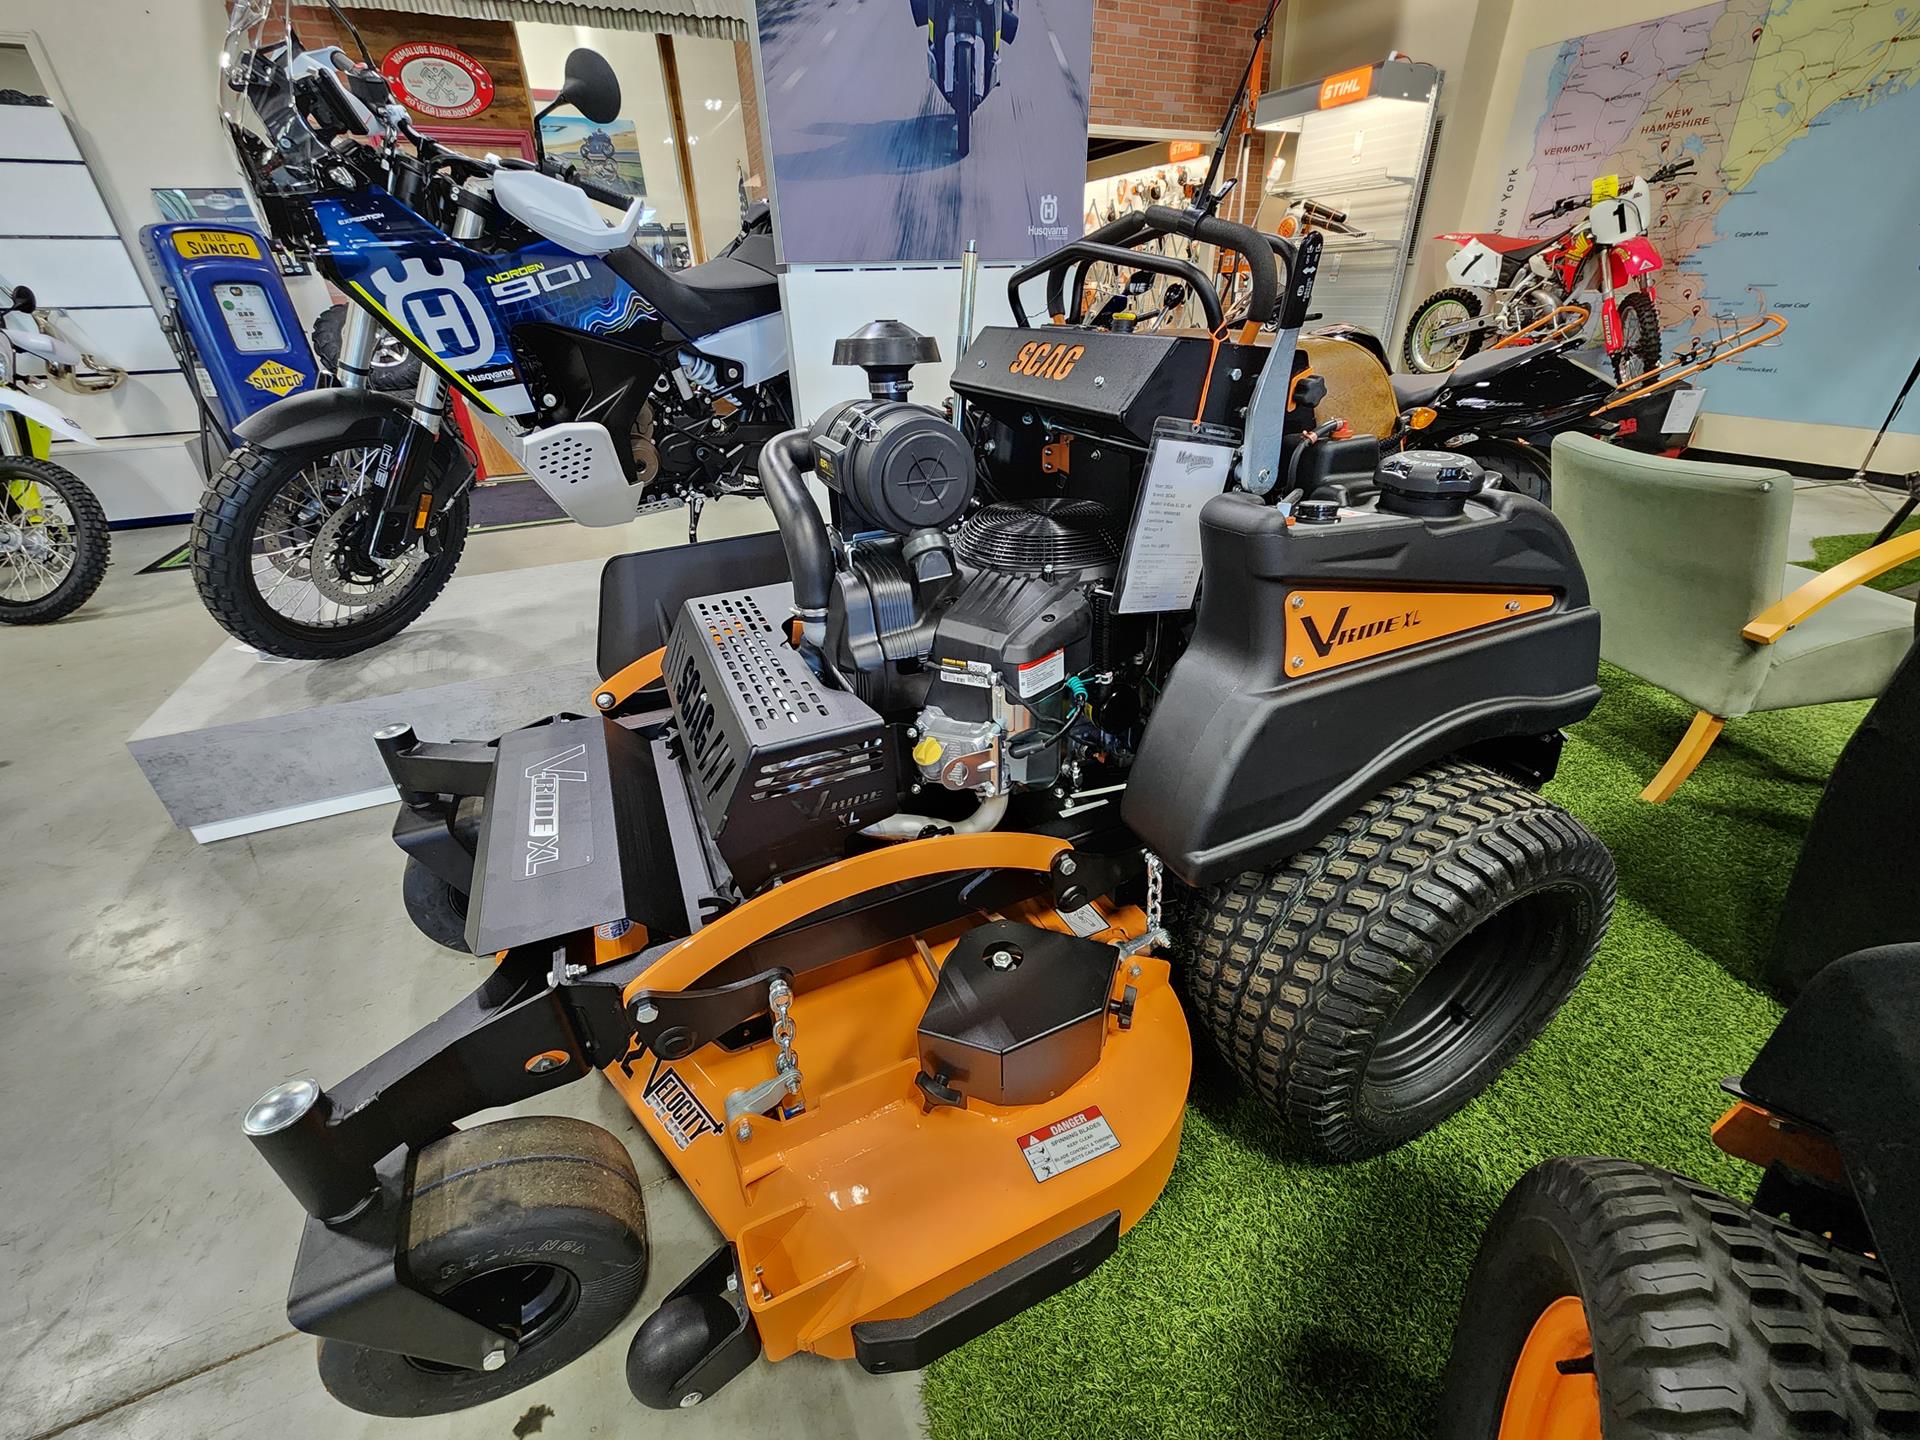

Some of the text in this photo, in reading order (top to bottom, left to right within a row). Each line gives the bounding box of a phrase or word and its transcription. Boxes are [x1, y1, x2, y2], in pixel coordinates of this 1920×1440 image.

[429, 45, 475, 71] ADVANTAGE
[1323, 78, 1361, 100] STIHL
[1664, 107, 1694, 120] NEW
[1640, 116, 1711, 135] HAMPSHIRE
[1544, 142, 1592, 156] VERMONT
[1502, 167, 1519, 205] York
[1612, 202, 1627, 234] 1
[200, 233, 229, 243] BLUE
[1028, 225, 1068, 238] Husqvarna
[187, 241, 250, 256] SUNOCO
[486, 262, 546, 284] NORDEN
[490, 260, 592, 306] 901
[1773, 302, 1793, 310] Cape
[1603, 314, 1612, 347] DUNLOP
[1009, 340, 1085, 381] SCAG
[253, 374, 302, 390] SUNOCO
[261, 367, 287, 377] BLUE
[467, 367, 515, 384] Husqvarna
[1401, 609, 1422, 630] XL
[676, 655, 715, 760] SCAG
[836, 811, 861, 827] XL
[525, 833, 559, 877] XL
[646, 1094, 691, 1151] PLUS
[1049, 1113, 1088, 1136] DANGER
[1051, 1121, 1102, 1147] SPINNING BLADES
[1066, 1134, 1094, 1149] KEEP CLEAR
[1055, 1154, 1070, 1164] BLADE
[1069, 1145, 1090, 1156] CONTACT
[1094, 1134, 1114, 1146] THROWN
[1063, 1154, 1085, 1166] OBJECTS
[1094, 1141, 1111, 1152] INJURE
